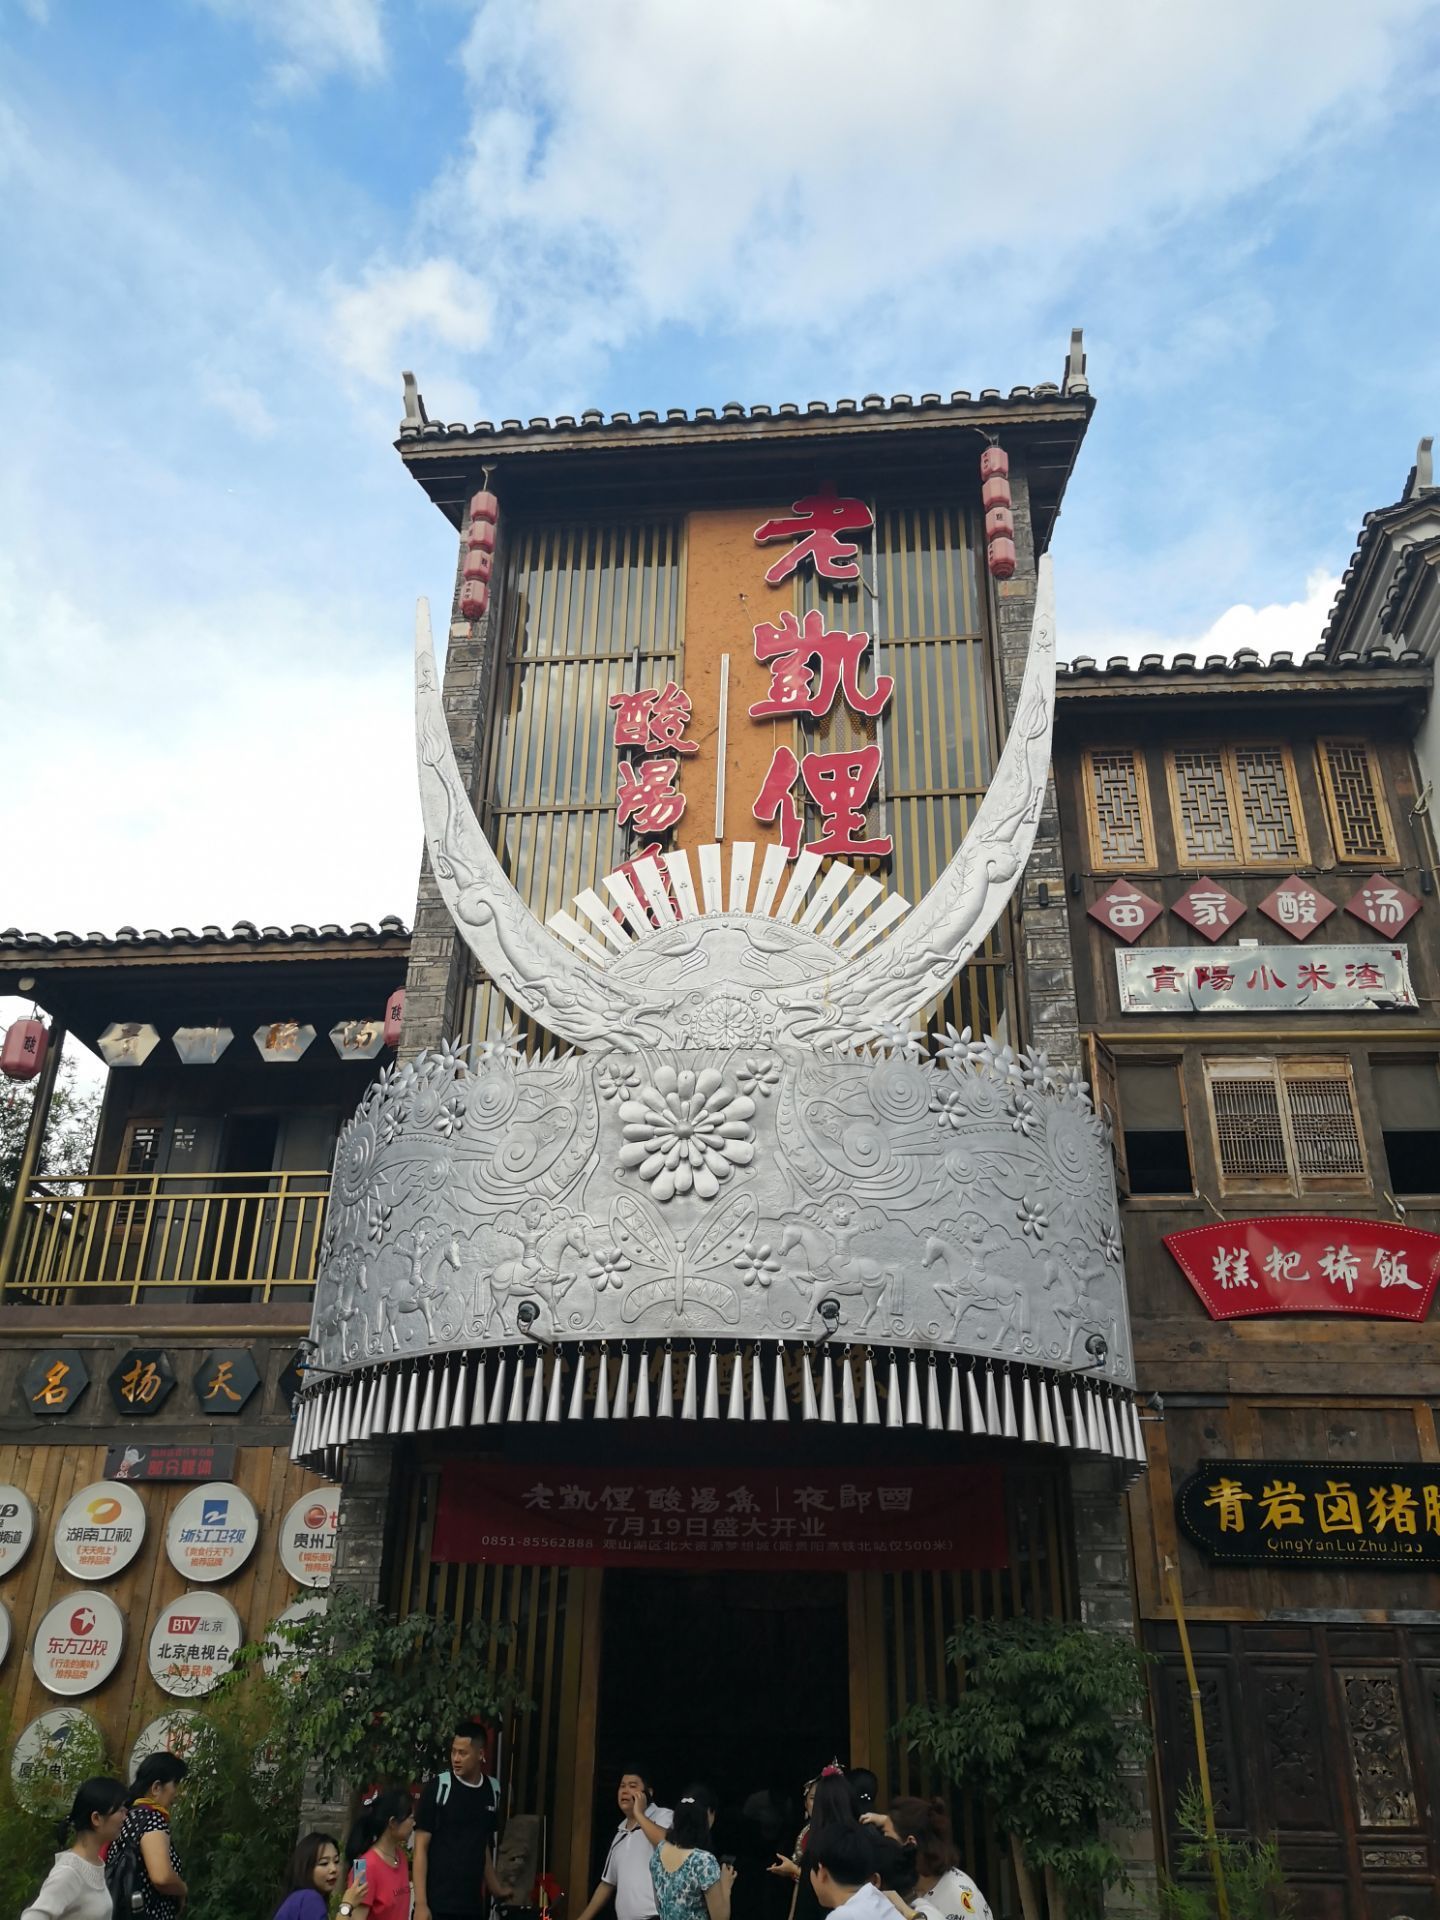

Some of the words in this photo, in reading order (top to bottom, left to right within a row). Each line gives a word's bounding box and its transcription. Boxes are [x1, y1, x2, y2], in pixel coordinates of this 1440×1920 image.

[1106, 889, 1404, 927] 苗家酸汤
[1145, 962, 1385, 993] 貴陽小米渣
[32, 1360, 304, 1405] 名扬天
[66, 1527, 133, 1543] 湖南卫视
[178, 1529, 246, 1544] 浙江卫视
[603, 1516, 828, 1538] 7月19日盛大开业
[481, 1535, 593, 1549] 0851-85562888
[173, 1619, 197, 1632] BTV
[198, 1620, 224, 1632] 北京
[47, 1637, 108, 1656] 东方卫视
[157, 1643, 230, 1662] 北京电视台
